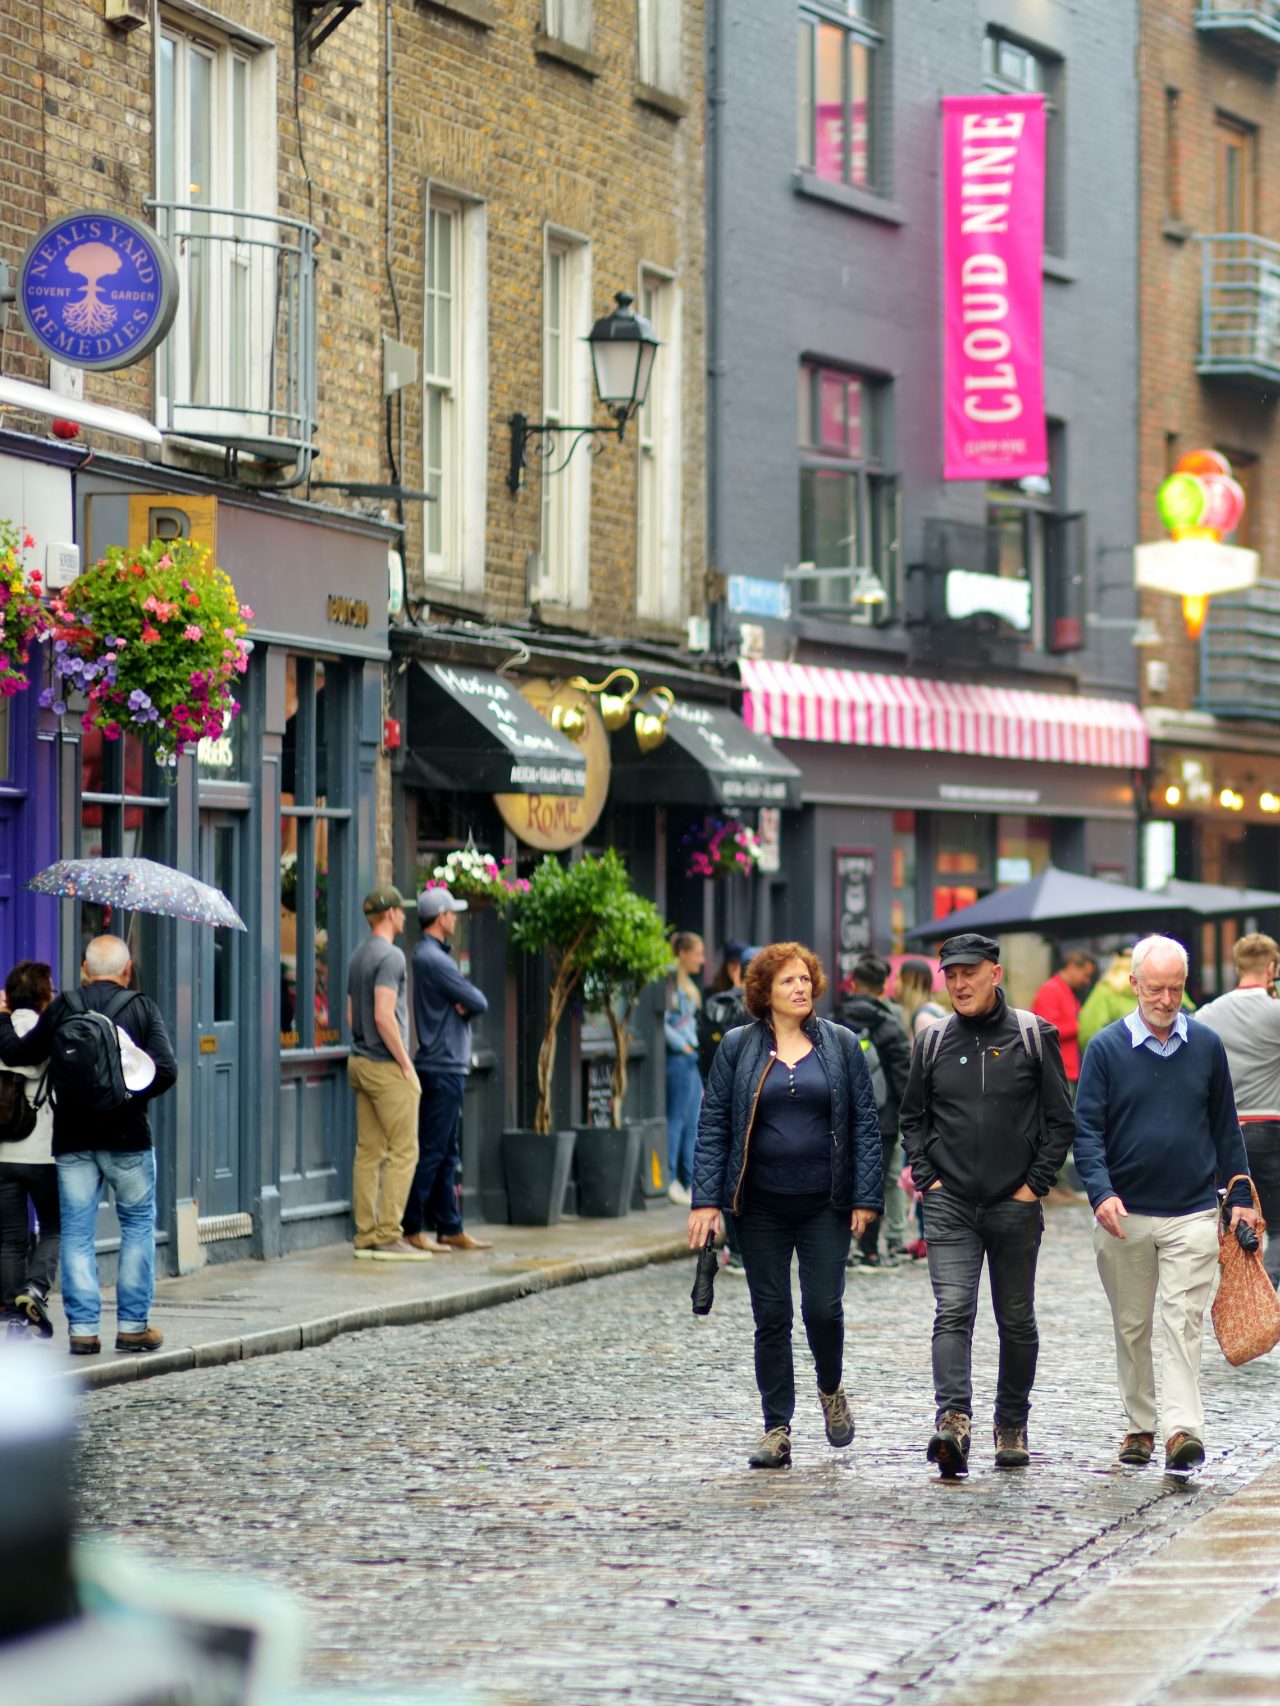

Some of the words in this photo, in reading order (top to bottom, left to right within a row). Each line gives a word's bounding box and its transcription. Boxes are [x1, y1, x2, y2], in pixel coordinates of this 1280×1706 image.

[960, 111, 1025, 234] NINE
[30, 222, 101, 279] NEAL'S
[111, 226, 155, 284] YARD
[28, 286, 72, 297] COVENT
[111, 290, 155, 301] GARDEN
[31, 305, 149, 356] REMEDIES
[962, 252, 1024, 425] CLOUD
[527, 793, 584, 837] ROME
